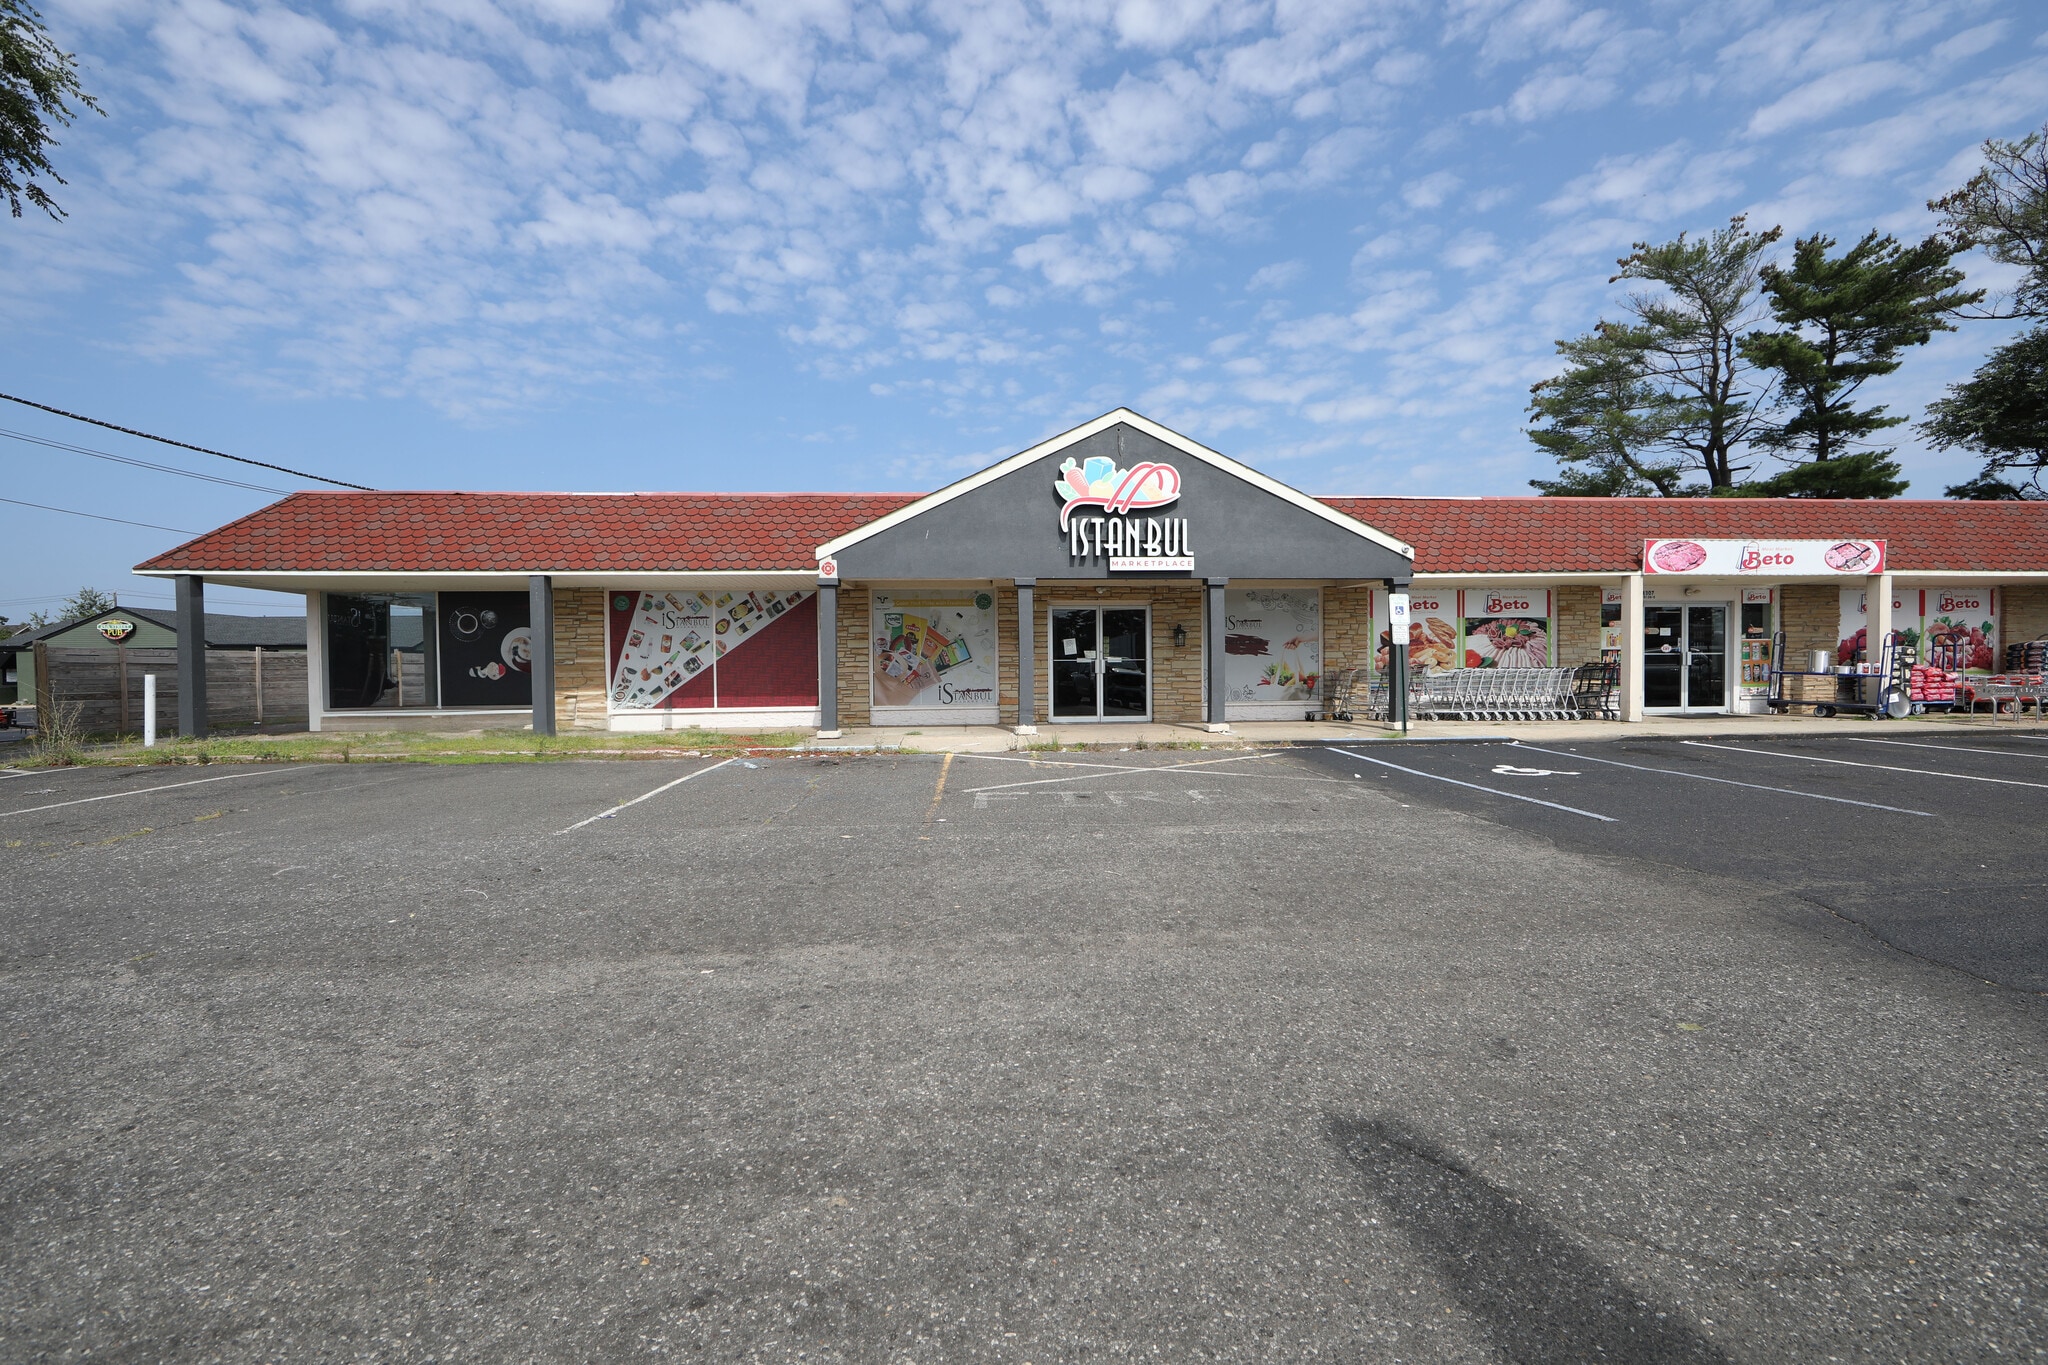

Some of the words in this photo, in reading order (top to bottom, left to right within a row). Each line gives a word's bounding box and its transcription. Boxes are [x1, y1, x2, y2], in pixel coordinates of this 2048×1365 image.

[1071, 517, 1194, 556] ISTANBUL
[1742, 551, 1795, 570] Beto
[1488, 598, 1529, 613] Beto
[1941, 597, 1980, 612] Beto
